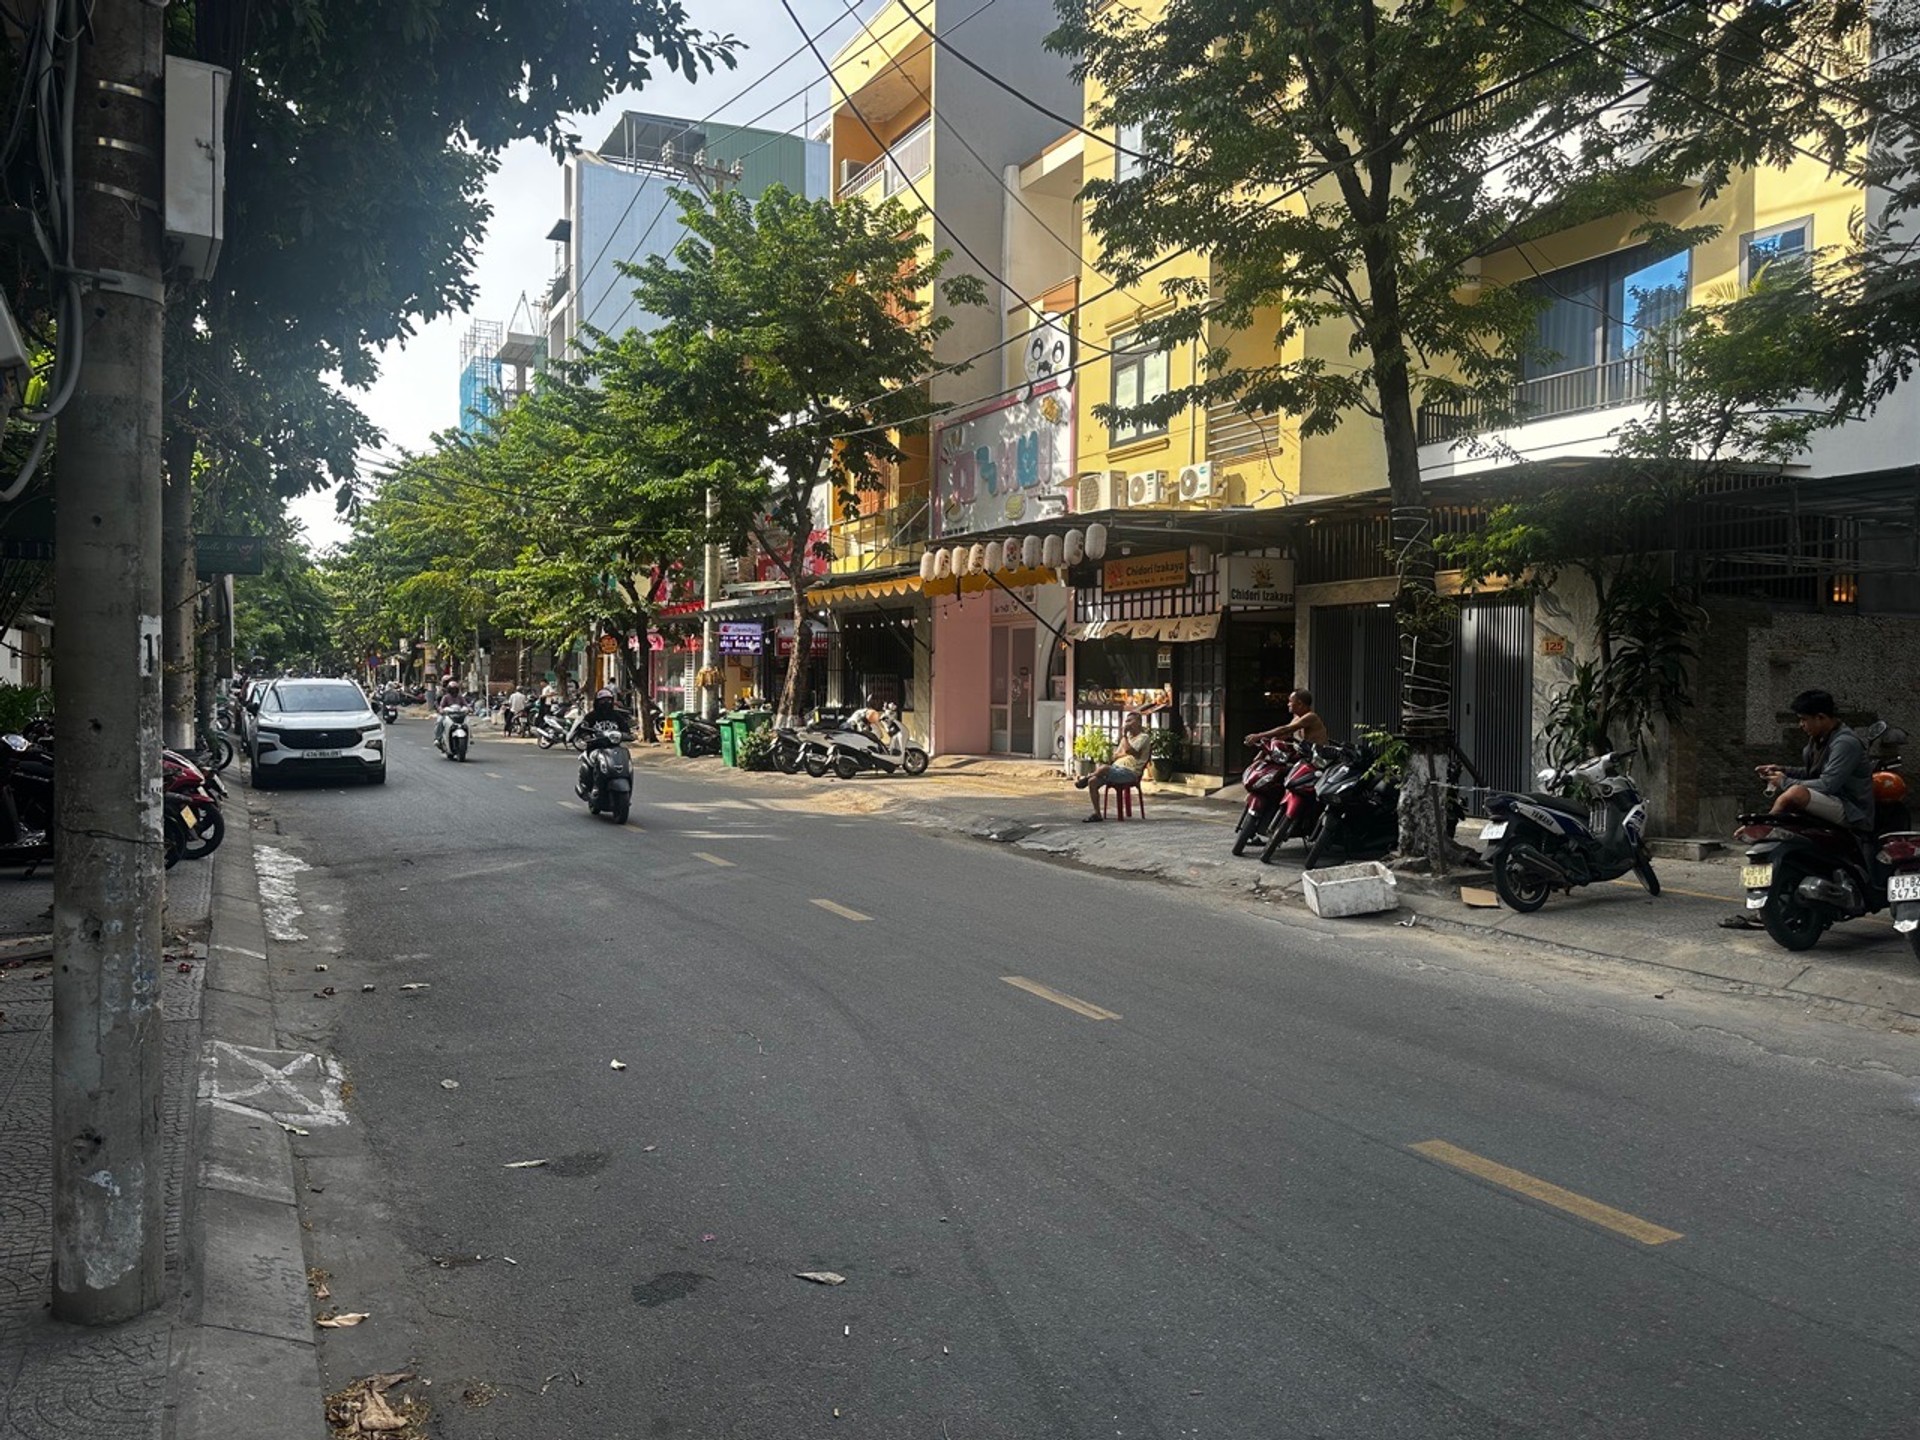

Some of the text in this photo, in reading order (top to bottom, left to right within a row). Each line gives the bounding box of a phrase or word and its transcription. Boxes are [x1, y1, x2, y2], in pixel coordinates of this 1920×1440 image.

[1126, 561, 1184, 576] Chidori Izakaya
[1231, 588, 1295, 603] Chidori Izakaya
[1545, 642, 1564, 651] 125
[1531, 810, 1554, 826] YAMAHA
[1890, 887, 1920, 900] 647.5
